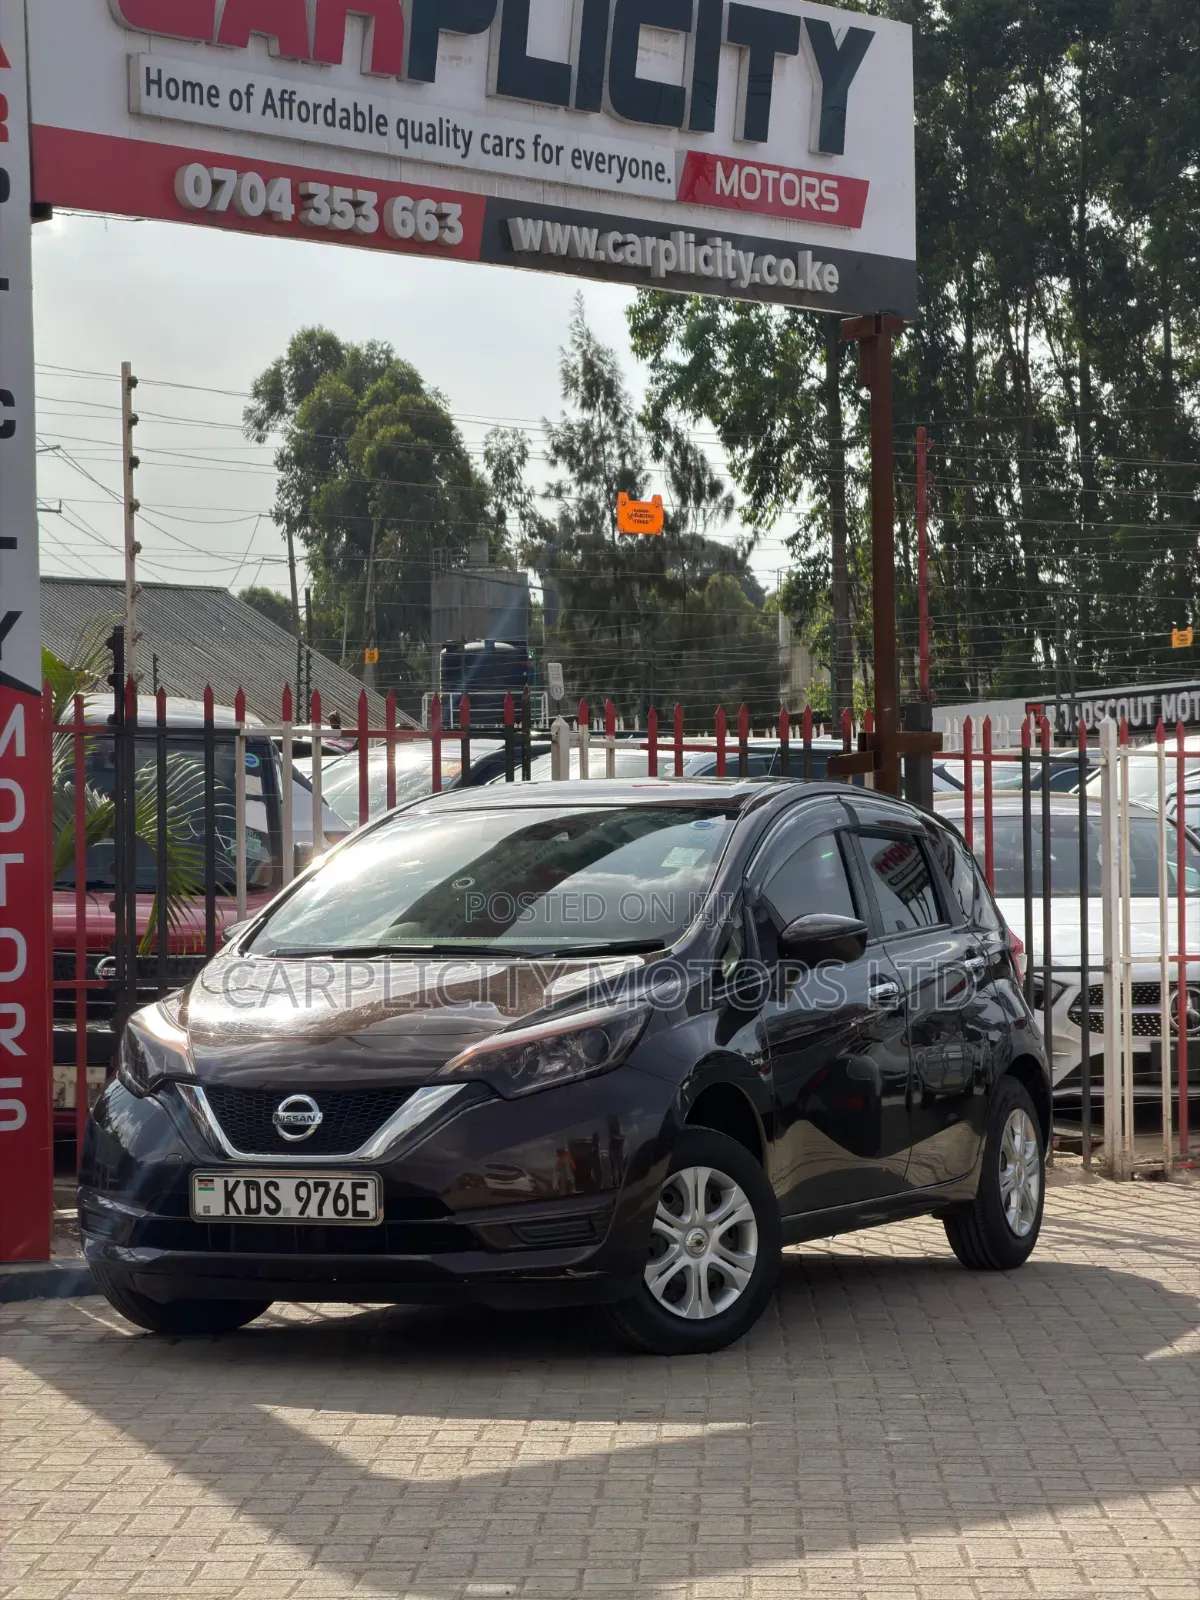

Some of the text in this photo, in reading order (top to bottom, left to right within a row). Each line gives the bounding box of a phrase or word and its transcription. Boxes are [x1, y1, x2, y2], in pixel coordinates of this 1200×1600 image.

[110, 0, 875, 156] PLICITY
[145, 66, 672, 184] Home of Affordable quality cars for everyone.
[175, 163, 464, 245] 0704 353 663
[715, 161, 840, 213] MOTORS
[507, 216, 840, 293] www.carplicity.co.ke
[275, 1114, 315, 1123] NISSAN
[223, 1179, 282, 1216] KDS
[295, 1180, 370, 1218] 976E
